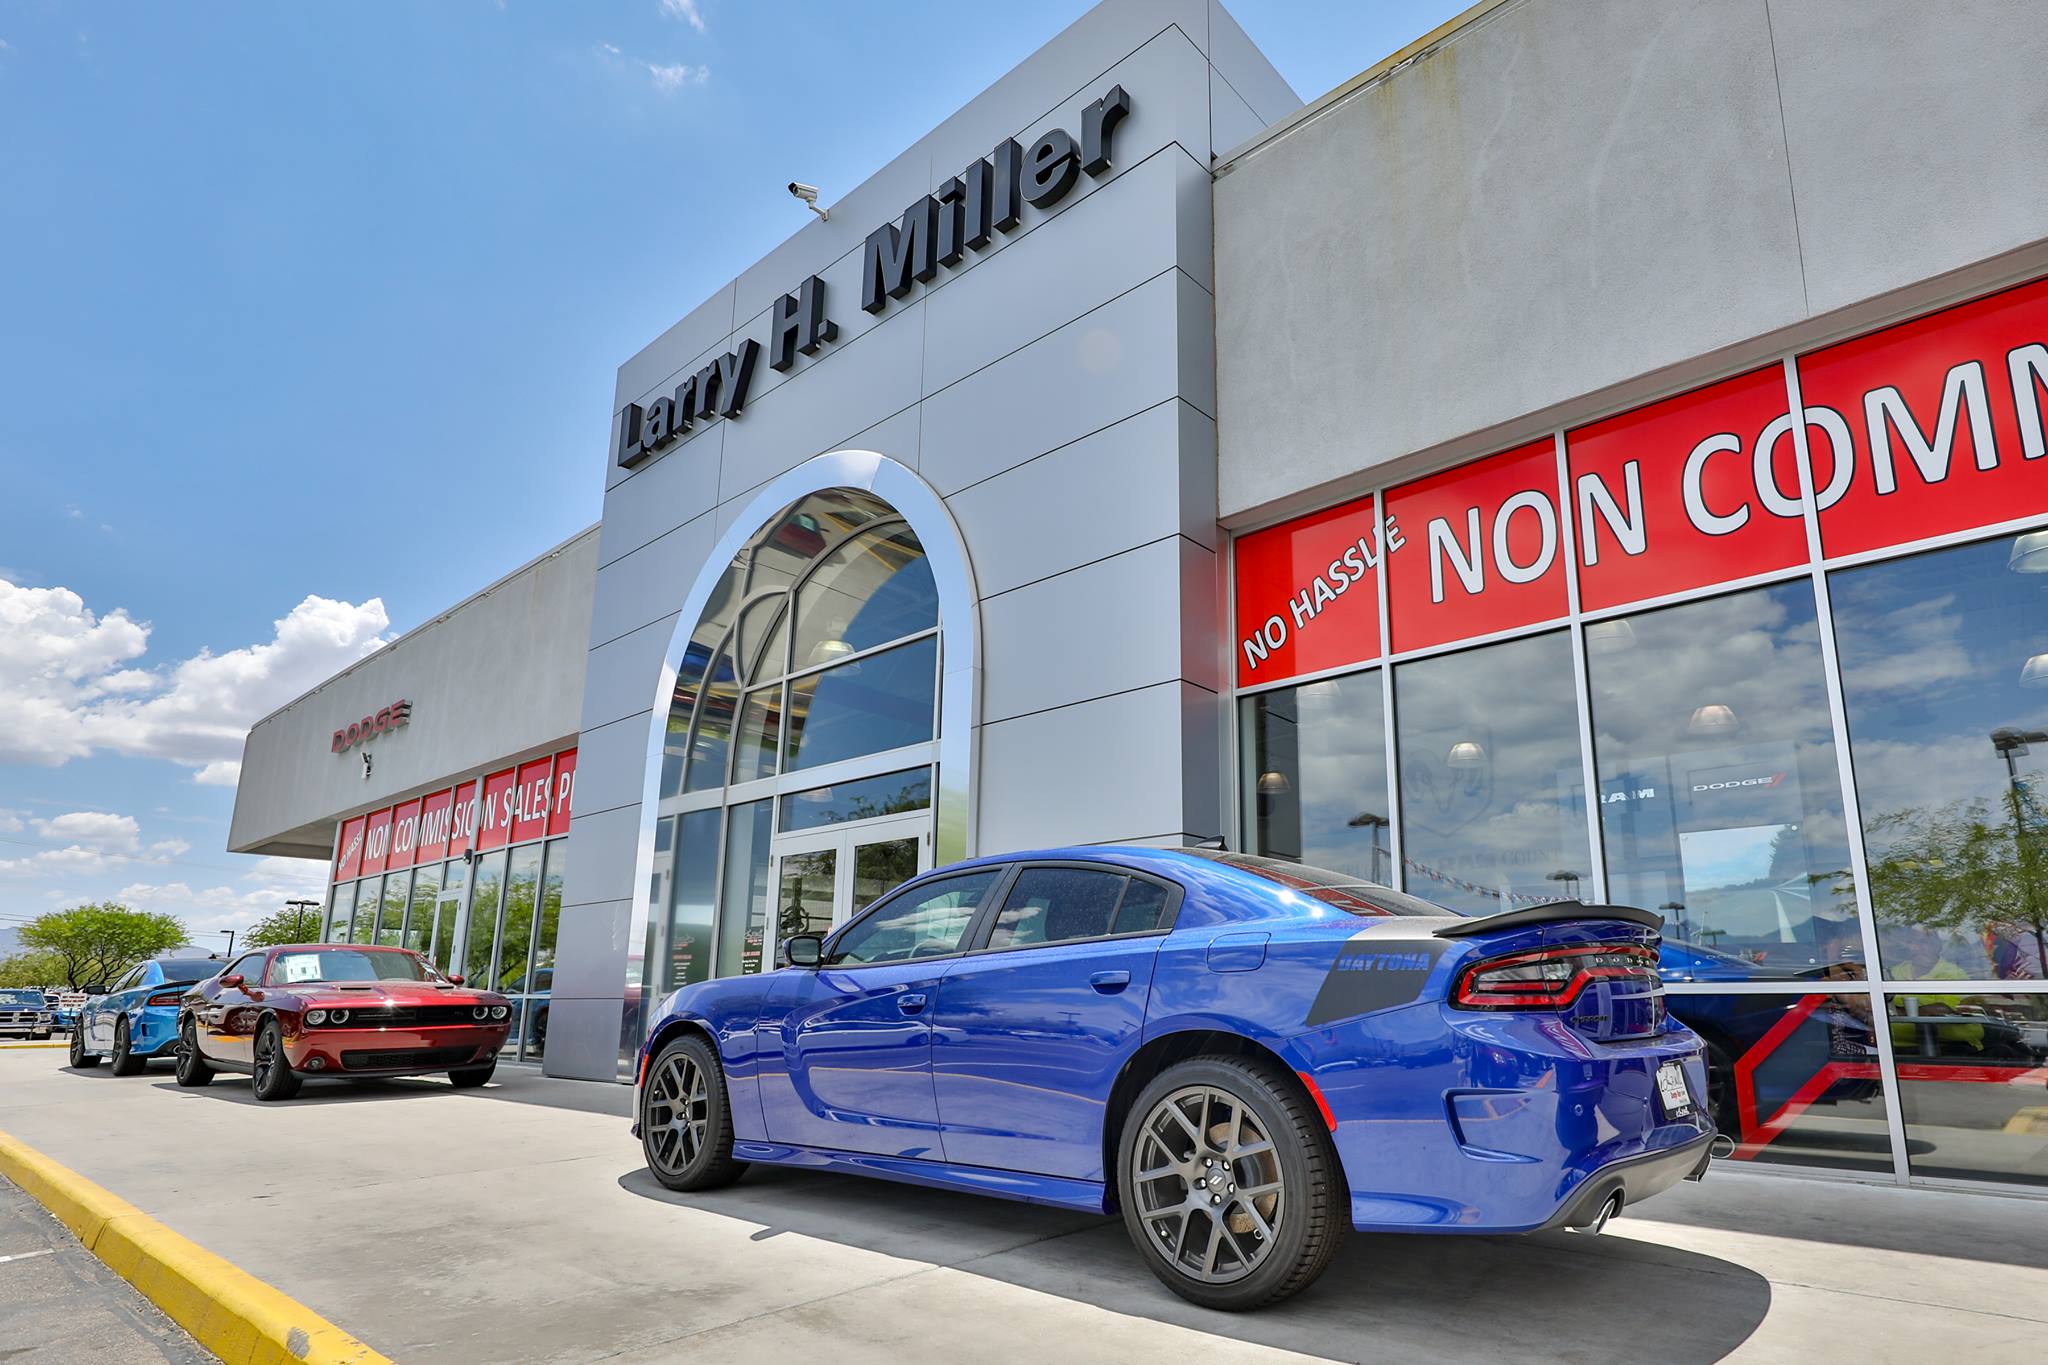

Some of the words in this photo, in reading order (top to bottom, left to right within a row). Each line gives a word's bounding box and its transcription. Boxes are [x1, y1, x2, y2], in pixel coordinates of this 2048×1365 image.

[617, 338, 760, 469] Larry
[769, 274, 839, 373] H.
[861, 83, 1131, 315] Miller
[1427, 459, 1647, 604] NON
[1243, 615, 1287, 670] NO
[1289, 514, 1406, 629] HASSLE
[331, 698, 413, 753] DODGE
[500, 775, 554, 827] SALES
[557, 769, 576, 814] P
[1693, 776, 1772, 792] DODGE
[1337, 953, 1430, 971] DAYTONA
